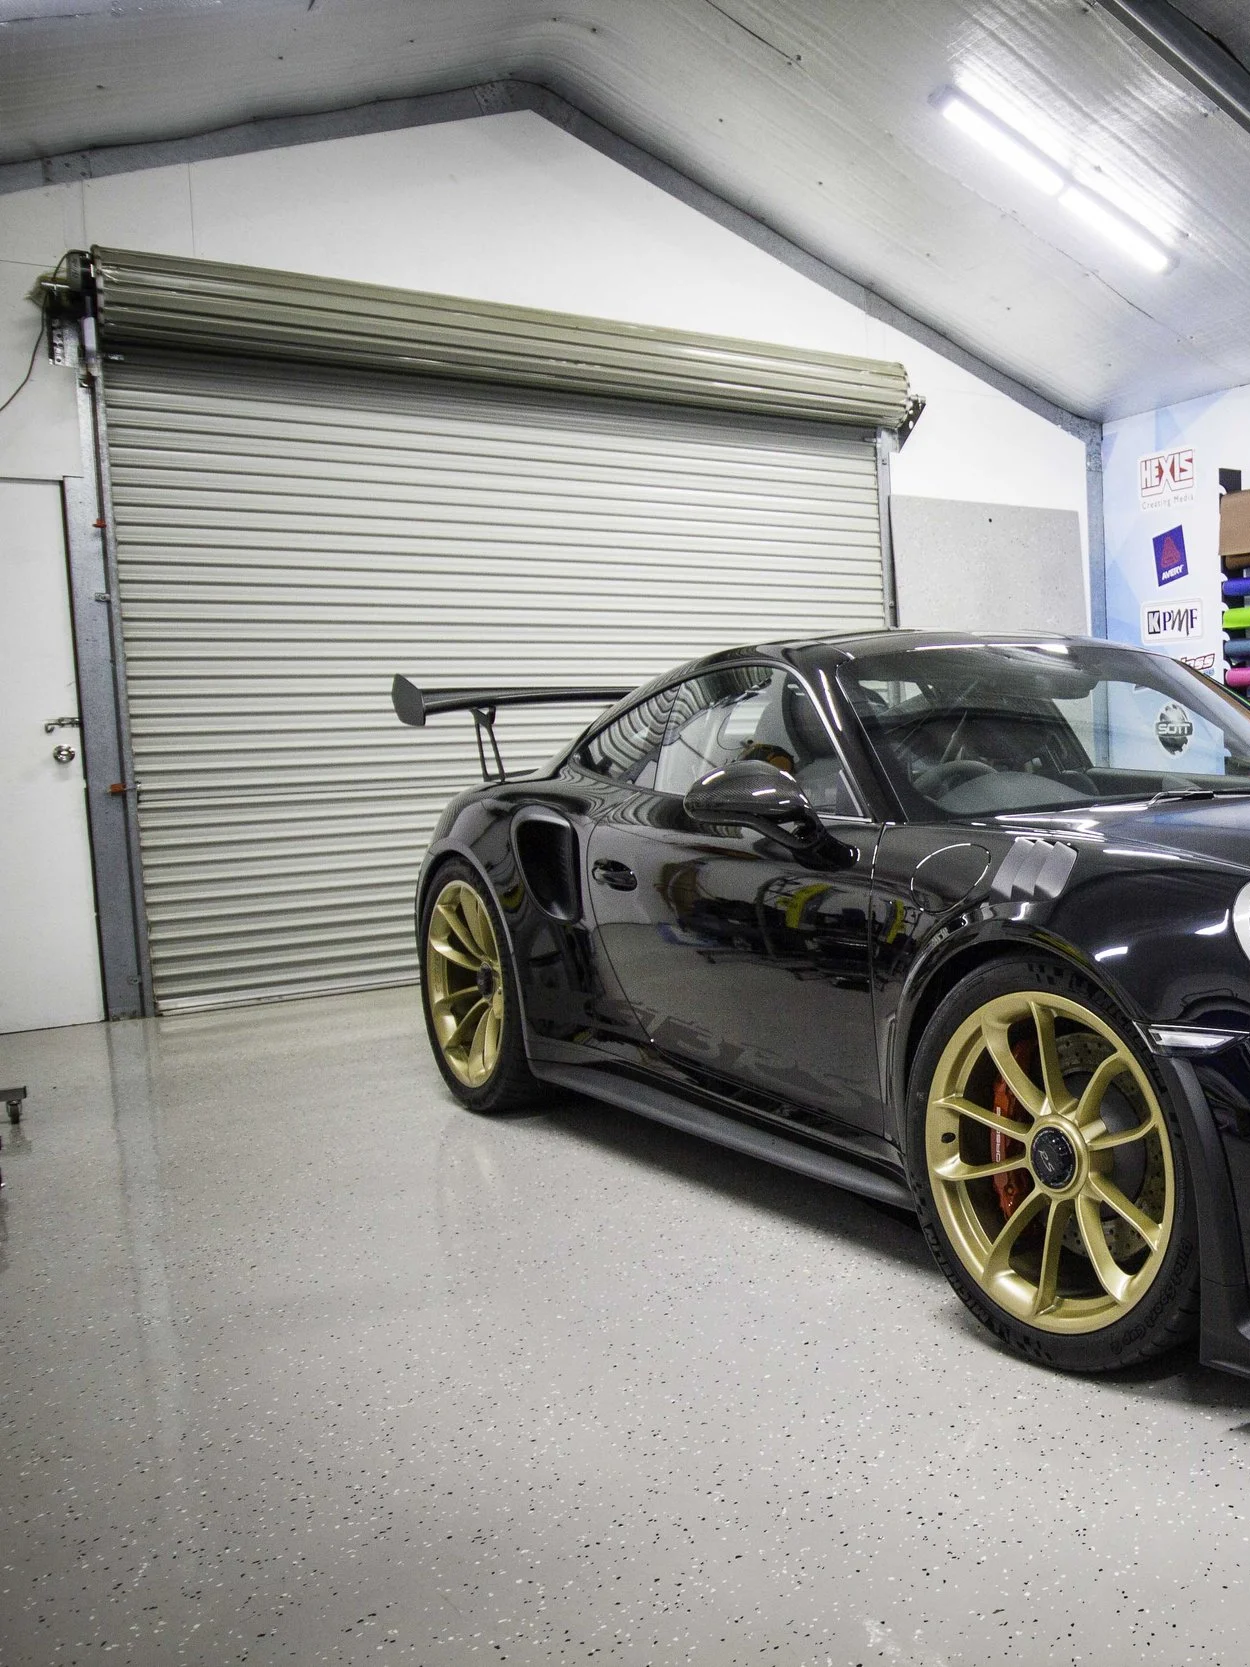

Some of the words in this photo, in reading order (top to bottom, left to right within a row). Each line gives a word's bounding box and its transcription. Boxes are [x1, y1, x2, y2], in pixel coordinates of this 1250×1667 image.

[1140, 449, 1194, 498] HEXIS
[1161, 564, 1185, 581] AVERY
[1146, 607, 1198, 636] KPMF
[1158, 722, 1191, 736] SOTT
